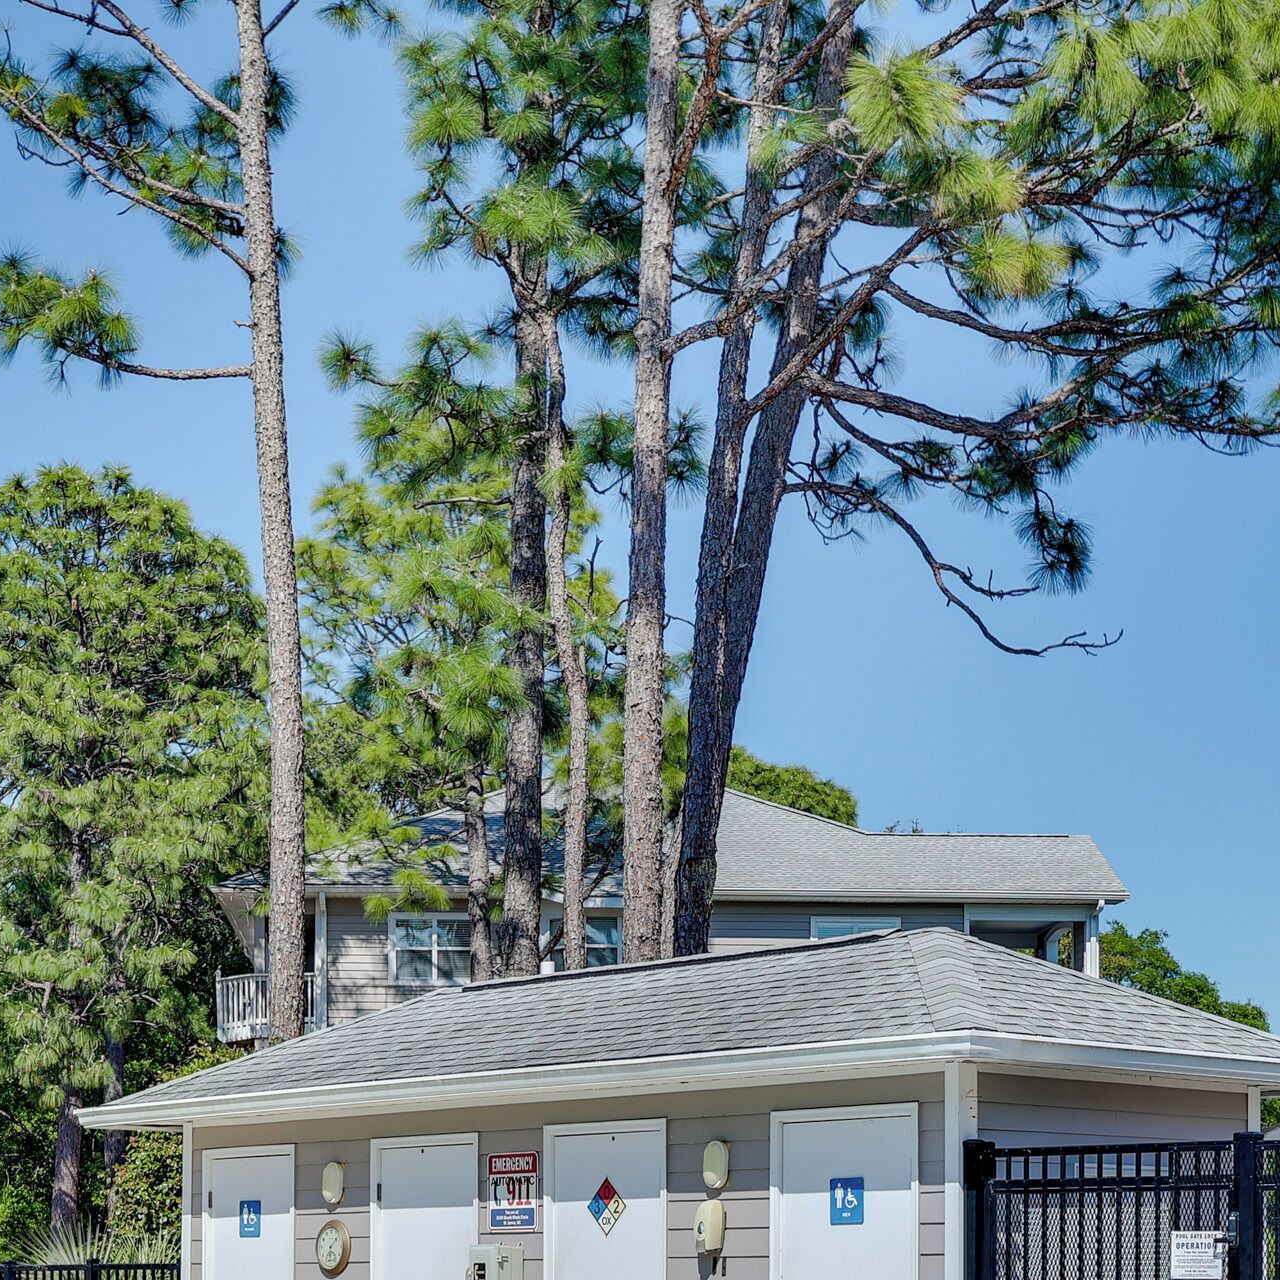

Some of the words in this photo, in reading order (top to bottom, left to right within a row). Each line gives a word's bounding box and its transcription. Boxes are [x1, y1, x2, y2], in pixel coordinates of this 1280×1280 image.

[492, 1156, 533, 1171] EMERGENCY
[491, 1175, 535, 1186] AUTOMATIC
[507, 1178, 532, 1206] 911
[604, 1185, 610, 1200] 0
[594, 1200, 600, 1214] 3
[613, 1200, 620, 1213] 2
[601, 1216, 611, 1225] OX
